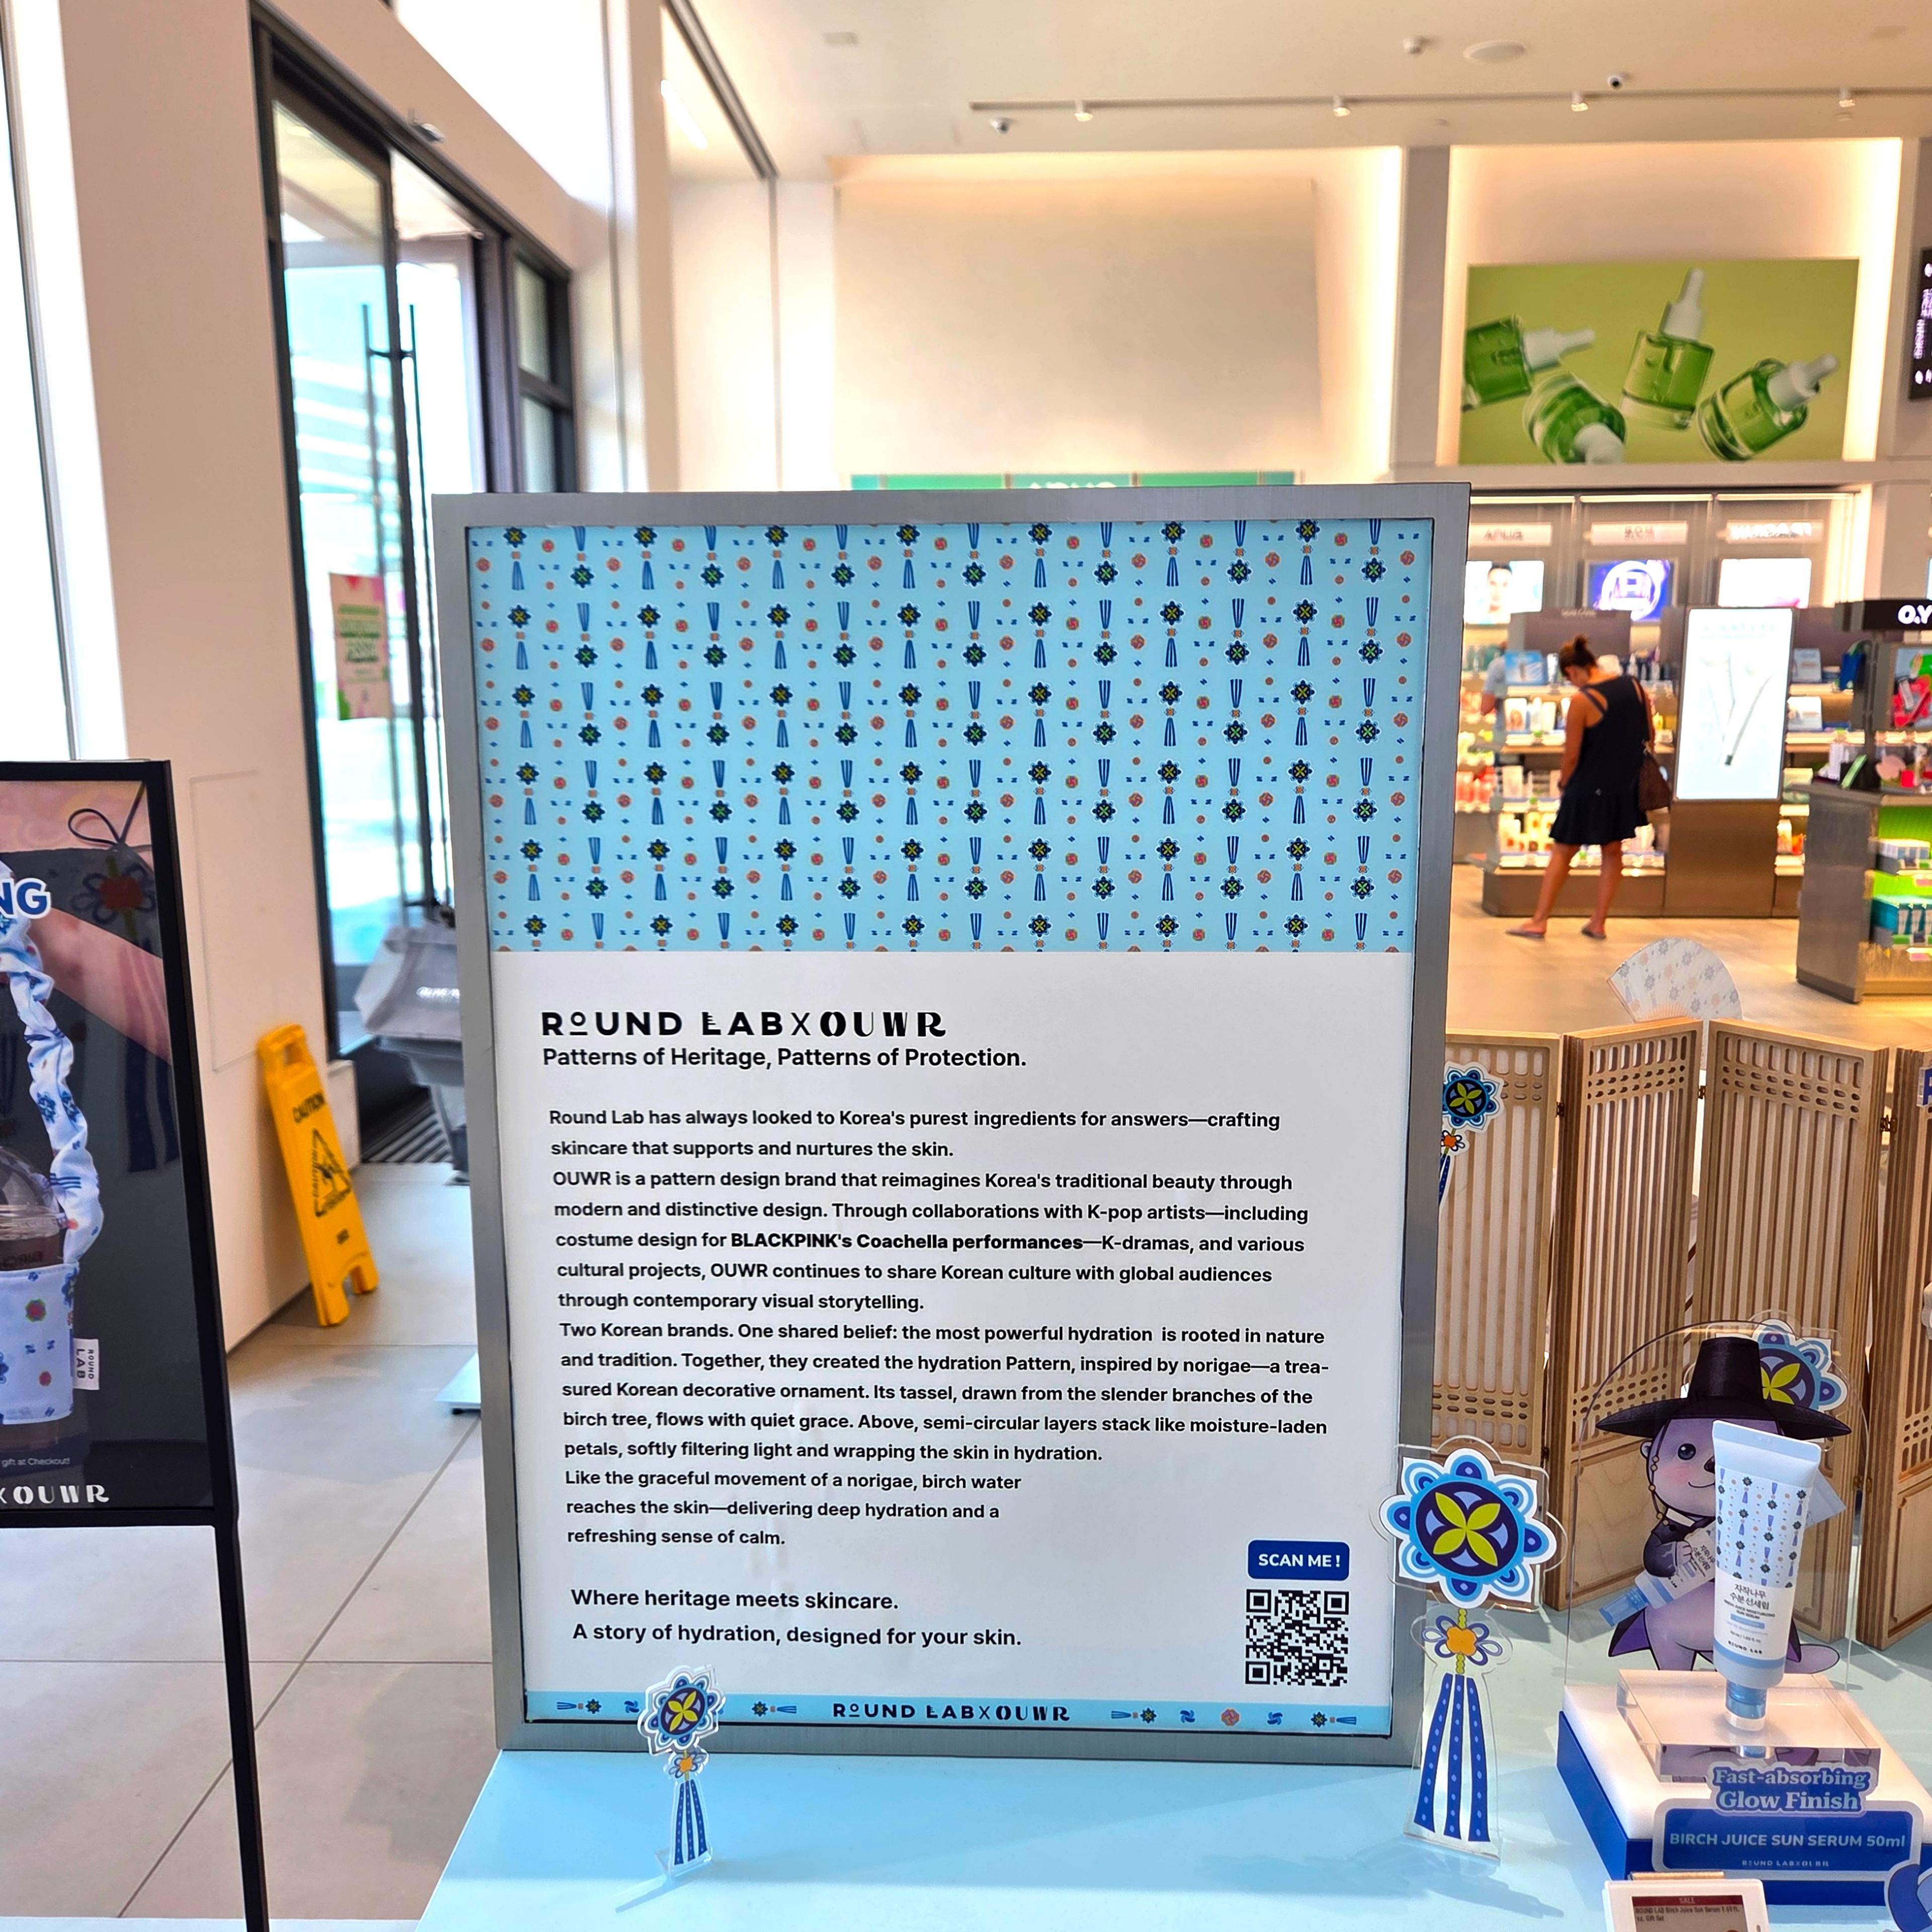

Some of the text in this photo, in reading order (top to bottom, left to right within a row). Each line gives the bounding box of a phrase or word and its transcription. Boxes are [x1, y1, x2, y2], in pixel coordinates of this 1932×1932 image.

[543, 1046, 1026, 1070] Patterns of Heritage, Patterns of Protection.
[549, 1110, 607, 1124] Round
[611, 1110, 645, 1124] Lab
[649, 1109, 681, 1124] has
[685, 1109, 748, 1128] always
[752, 1110, 813, 1124] looked
[816, 1111, 835, 1125] to
[840, 1110, 905, 1125] Korea's
[910, 1112, 969, 1129] purest
[974, 1110, 1076, 1130] ingredients
[1080, 1110, 1107, 1126] for
[551, 1140, 953, 1159] skincare that supports and nurtures the skin.
[553, 1170, 1292, 1193] OUWR is a pattern design brand that reimagines Korea's traditional beauty through
[555, 1233, 633, 1247] costume
[637, 1232, 697, 1250] design
[701, 1232, 728, 1247] for
[731, 1233, 852, 1248] BLACKPINK's
[856, 1234, 948, 1249] Coachella
[1198, 1236, 1233, 1251] and
[1237, 1236, 1305, 1252] various
[557, 1293, 924, 1313] through contemporary visual storytelling.
[76, 1348, 86, 1379] LAB
[560, 1352, 594, 1366] and
[597, 1352, 678, 1367] tradition.
[680, 1353, 765, 1372] Together,
[768, 1353, 809, 1372] they
[813, 1354, 880, 1369] created
[883, 1355, 914, 1370] the
[918, 1355, 1001, 1373] hydration
[1006, 1356, 1076, 1375] Pattern,
[1080, 1356, 1152, 1375] inspired
[1157, 1357, 1179, 1376] by
[1284, 1360, 1329, 1374] trea-
[563, 1411, 1327, 1434] birch tree, flows with quiet grace. Above, semi-circular layers stack like moisture-laden
[566, 1470, 1022, 1492] Like the graceful movement of a norigae, birch water
[567, 1500, 636, 1514] reaches
[639, 1500, 669, 1514] the
[817, 1502, 861, 1520] deep
[865, 1502, 947, 1520] hydration
[952, 1504, 985, 1518] and
[989, 1507, 999, 1518] a
[568, 1528, 785, 1546] refreshing sense of calm.
[1258, 1554, 1304, 1567] SCAN
[1308, 1554, 1332, 1567] ME
[571, 1589, 898, 1611] Where heritage meets skincare.
[573, 1623, 1021, 1648] A story of hydration, designed for your skin.
[1714, 1768, 1868, 1789] Fast-absorbing
[1719, 1791, 1858, 1810] Glow Finish
[1669, 1832, 1906, 1847] BIRCH JUICE SUN SERUM 50ml
